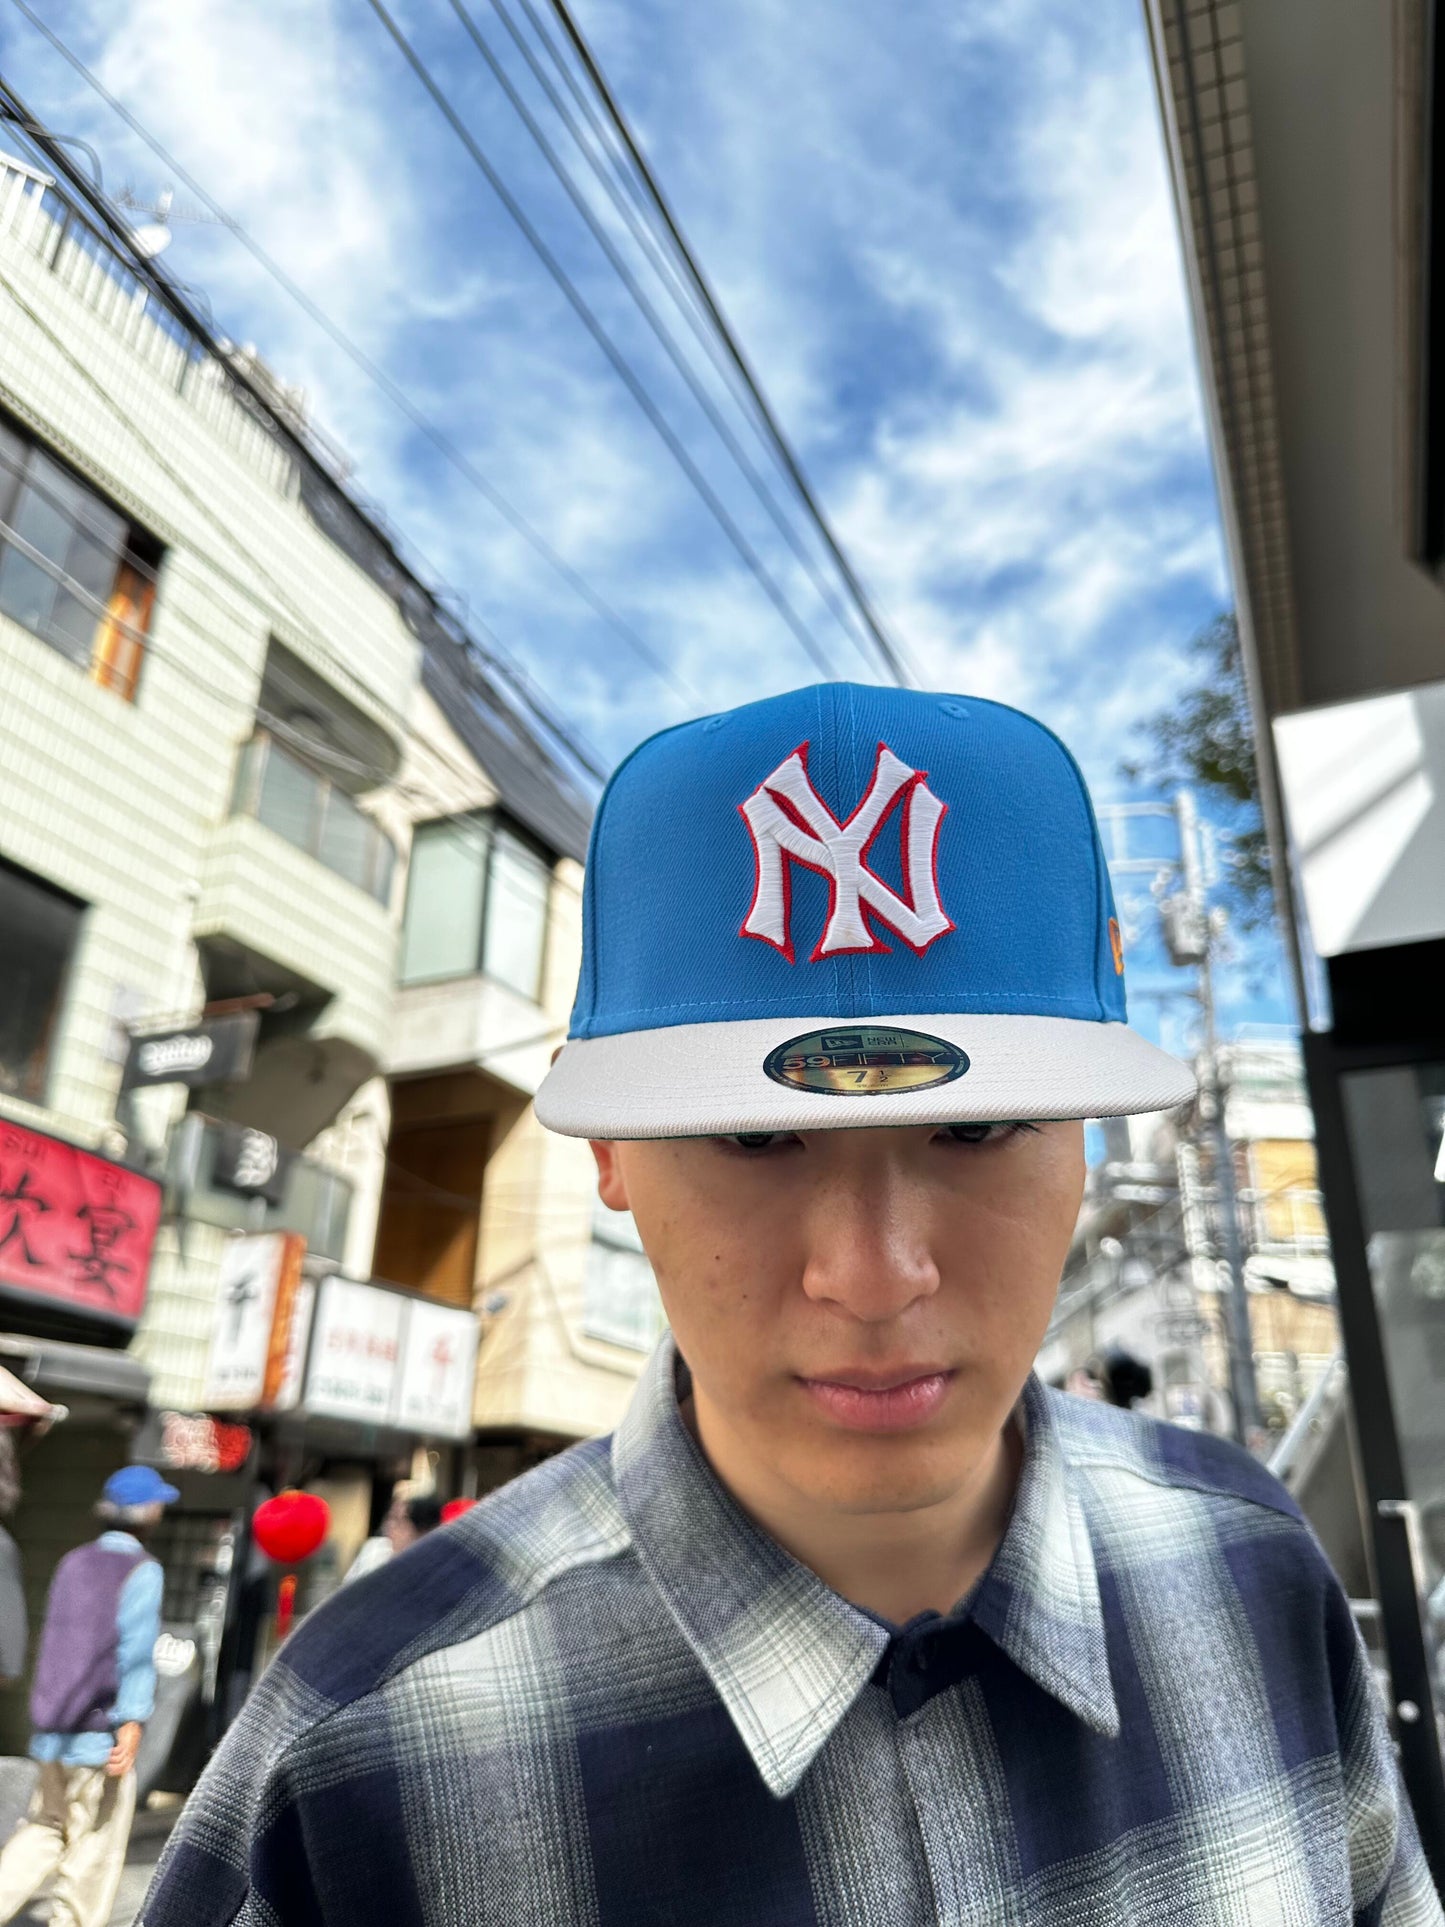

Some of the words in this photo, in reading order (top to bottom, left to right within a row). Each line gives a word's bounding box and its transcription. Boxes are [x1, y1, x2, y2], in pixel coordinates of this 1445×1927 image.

[737, 740, 957, 965] NY
[782, 1051, 946, 1071] 59FIFTY
[846, 1070, 869, 1083] 7
